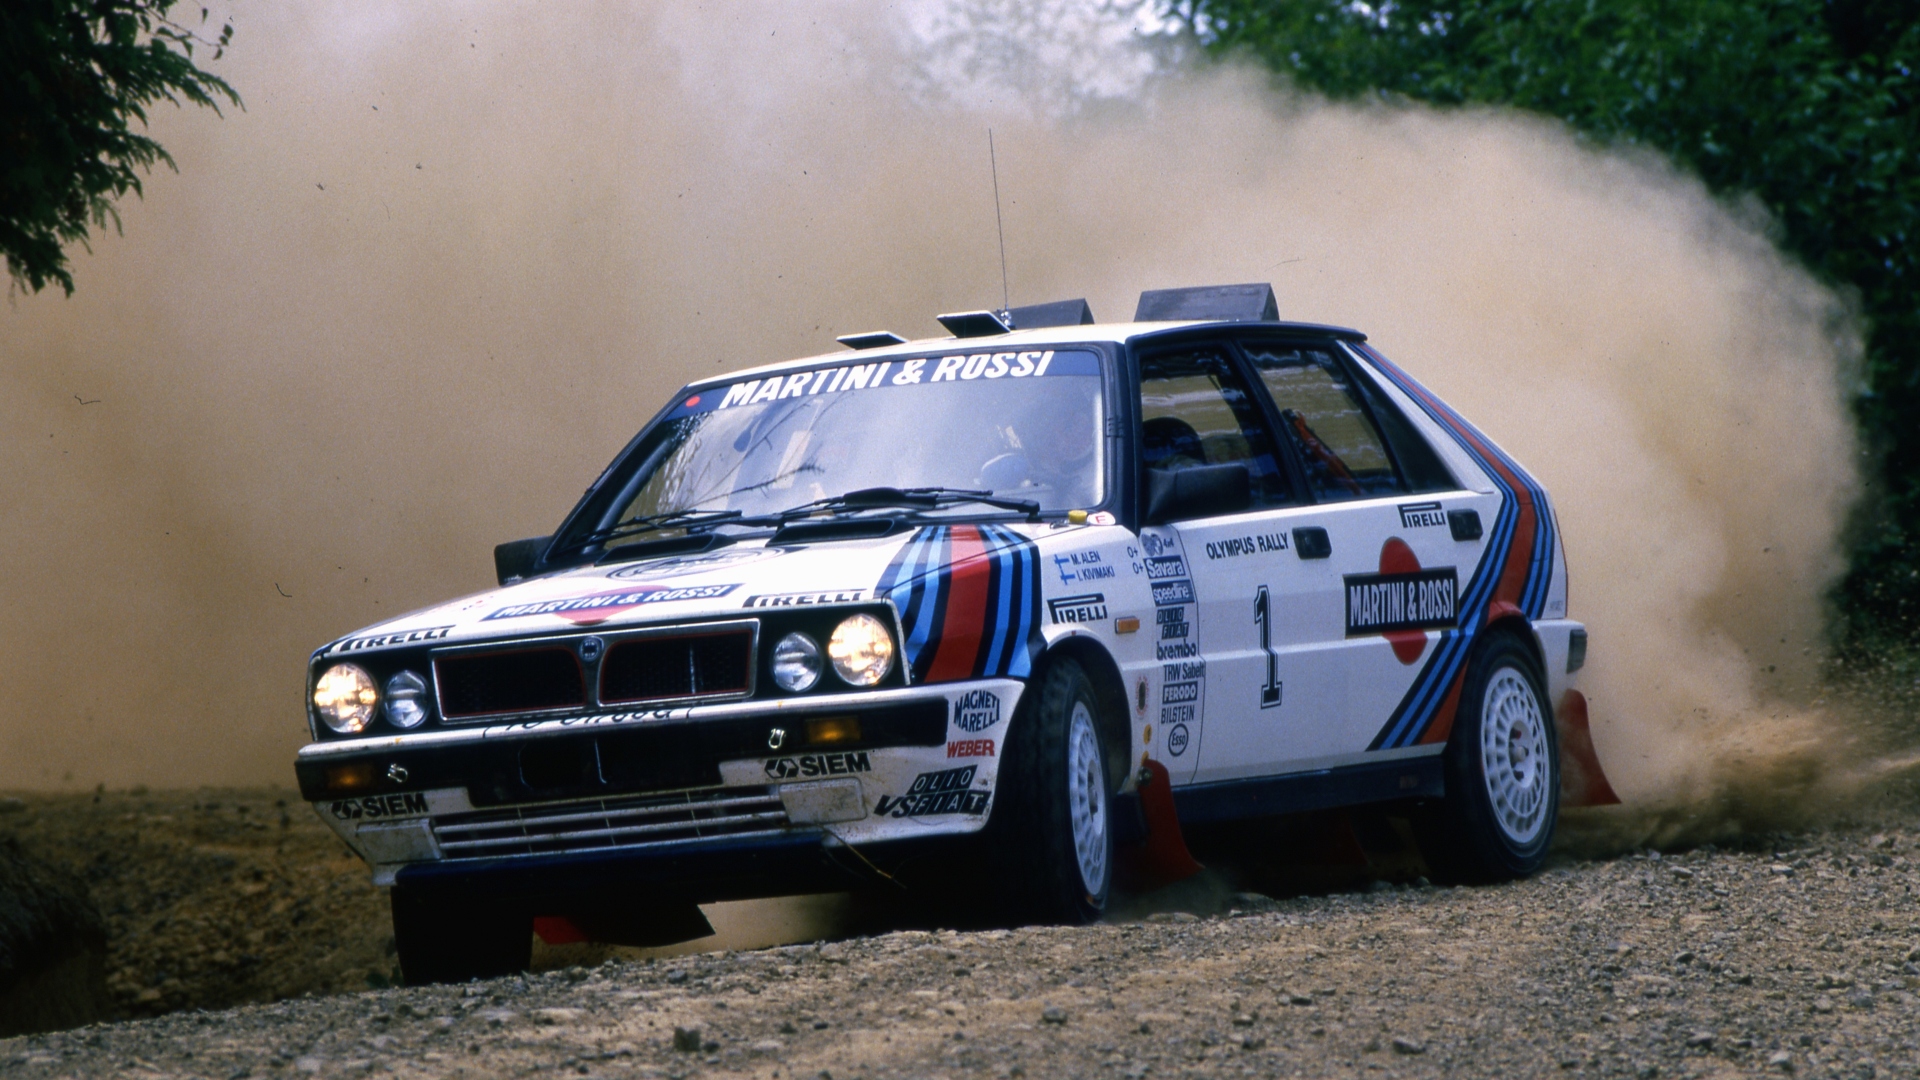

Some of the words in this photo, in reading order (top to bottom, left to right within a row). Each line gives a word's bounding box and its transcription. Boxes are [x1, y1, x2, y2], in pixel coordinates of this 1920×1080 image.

[718, 361, 891, 410] MARTINI
[892, 358, 927, 386] &
[931, 350, 1055, 383] ROSSI
[1398, 501, 1446, 528] PIRELLI
[1206, 535, 1256, 560] OLYMPUS
[1257, 532, 1289, 552] RALLY
[1070, 554, 1081, 565] M.
[1081, 551, 1101, 564] ALEN
[1146, 558, 1185, 578] Savara
[1082, 566, 1115, 580] KIVIMAKI
[494, 594, 619, 618] MARTINI
[620, 590, 643, 604] &
[647, 584, 731, 602] ROSSI
[742, 589, 867, 608] PIRELLI
[1153, 582, 1190, 604] speedline
[1350, 580, 1404, 626] MARTINI
[1407, 580, 1417, 622] &
[1419, 578, 1454, 620] ROSSI
[1047, 593, 1108, 624] PIRELLI
[1157, 608, 1183, 624] OLIO
[328, 624, 456, 652] PIRELLI
[1163, 624, 1189, 639] FIAT
[1156, 639, 1197, 661] brembo
[1253, 584, 1283, 710] 1
[1163, 664, 1180, 681] TRW
[1182, 661, 1205, 680] Sabelt
[954, 690, 1000, 712] MAGNETI
[1163, 684, 1197, 702] FERODO
[953, 711, 1000, 732] MARELLI
[1161, 705, 1195, 724] BILSTEIN
[947, 739, 995, 758] WEBER
[1171, 732, 1187, 746] Esso
[800, 752, 871, 776] SIEM
[914, 769, 972, 792] OLIO
[362, 793, 429, 817] SIEM
